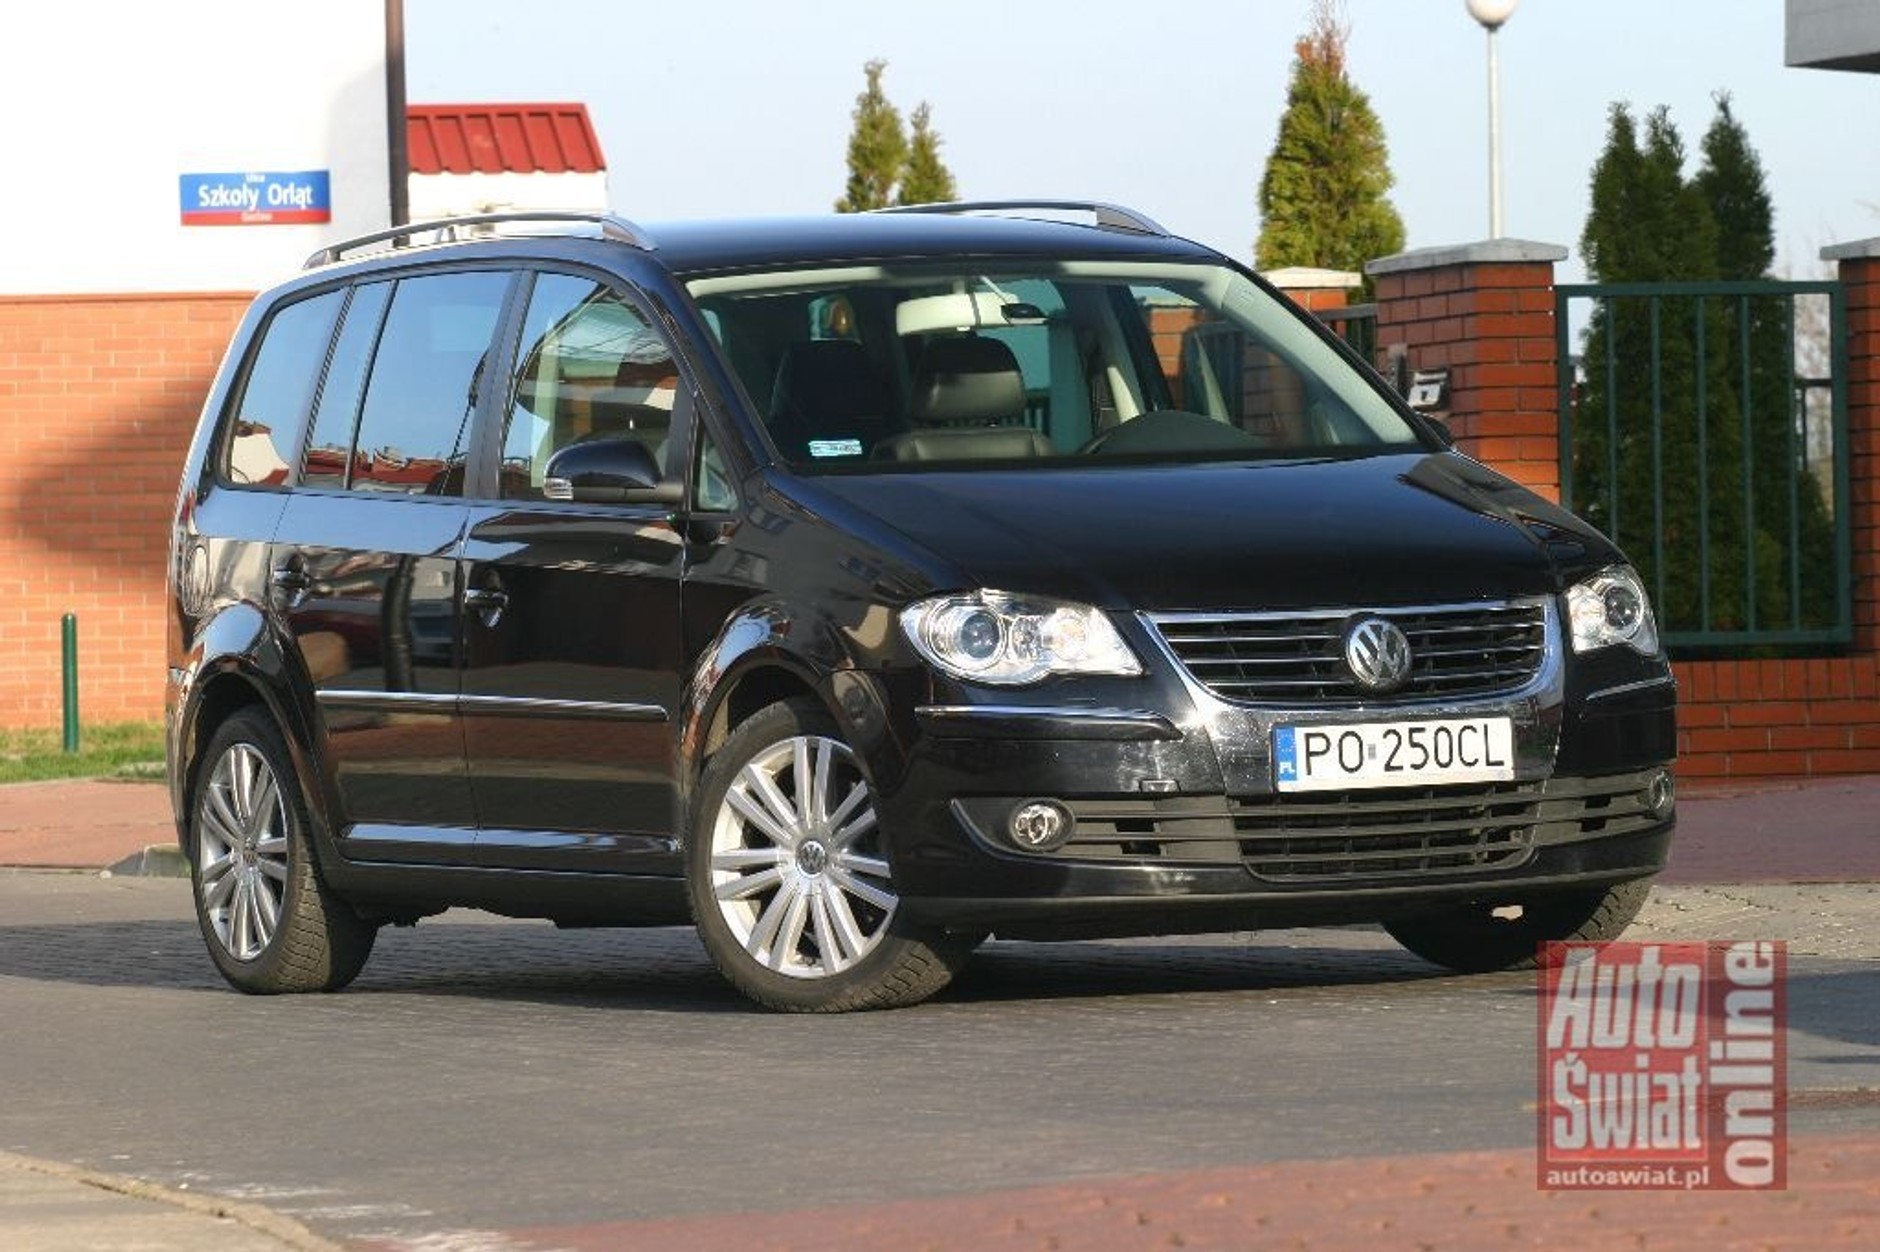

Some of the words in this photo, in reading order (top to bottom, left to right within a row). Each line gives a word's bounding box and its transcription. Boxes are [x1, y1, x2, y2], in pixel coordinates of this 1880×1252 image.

[267, 181, 313, 210] Orląt
[1304, 730, 1364, 776] PO
[1382, 724, 1505, 772] 250CL
[1279, 761, 1296, 774] PL
